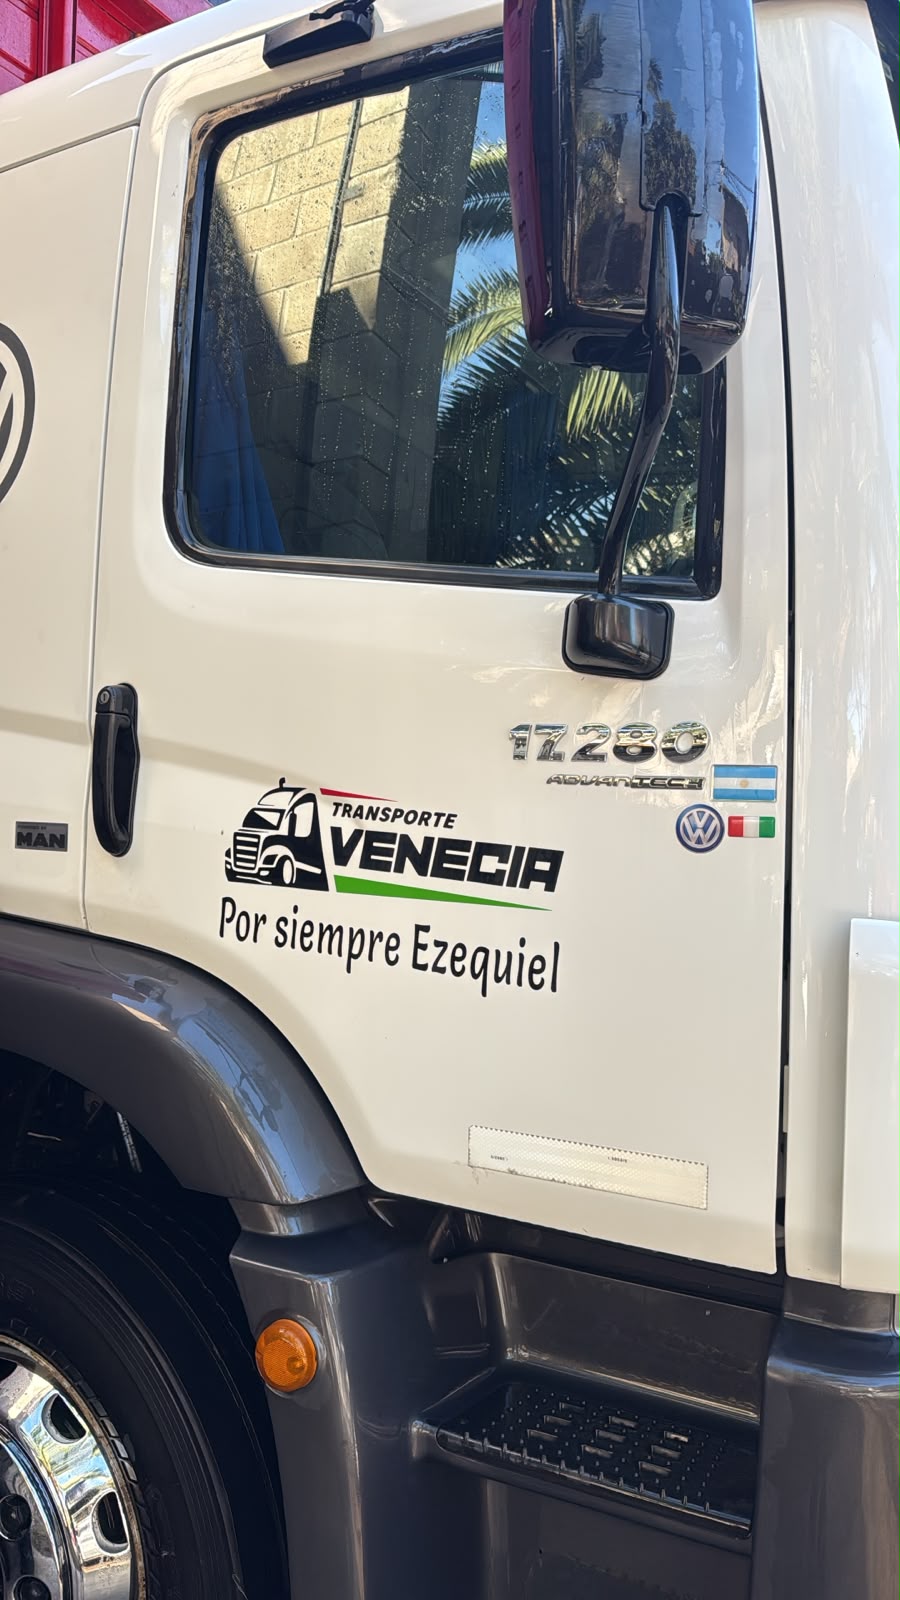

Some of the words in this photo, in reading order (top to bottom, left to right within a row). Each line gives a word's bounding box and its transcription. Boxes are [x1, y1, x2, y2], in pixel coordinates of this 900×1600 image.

[331, 802, 458, 829] TRANSPORTE
[16, 831, 66, 848] MAN
[330, 826, 565, 892] VENECIA
[219, 896, 267, 943] Por
[274, 905, 401, 974] siempre
[411, 923, 560, 998] Ezequiel
